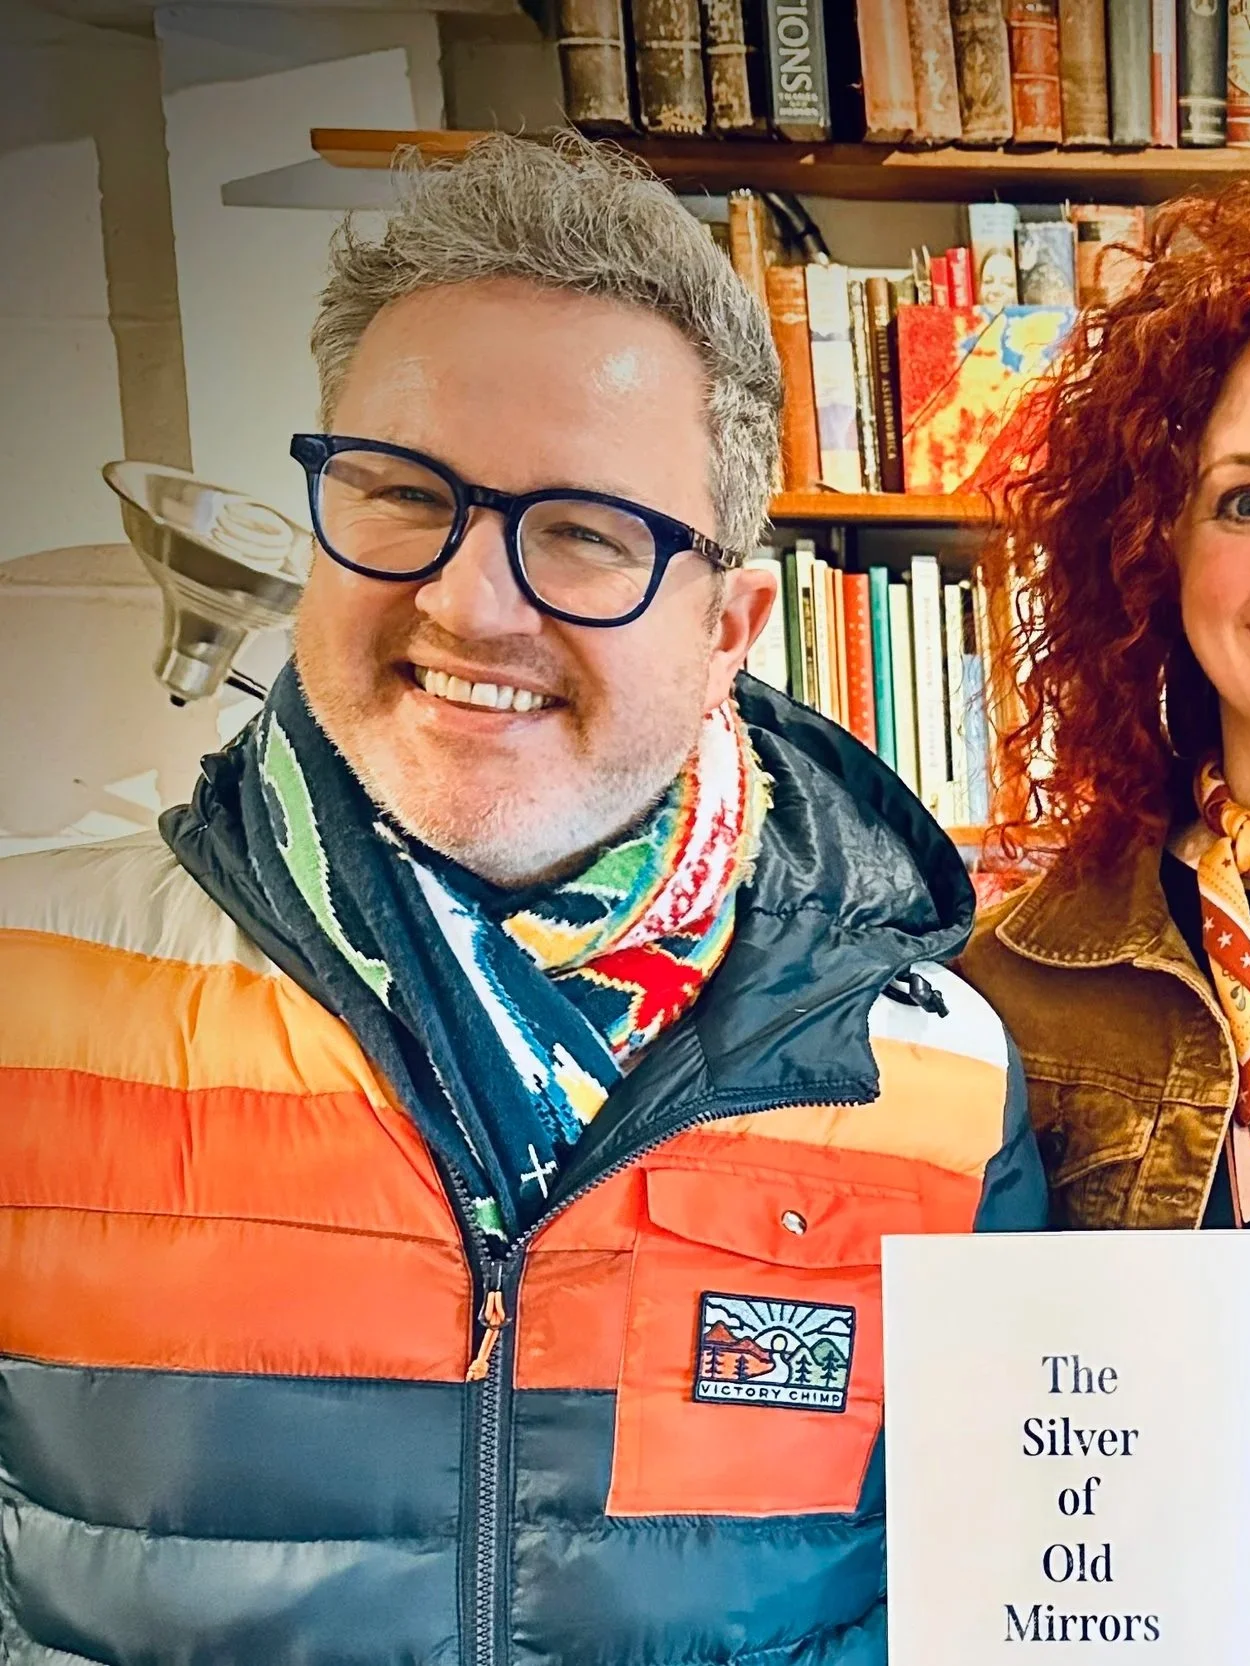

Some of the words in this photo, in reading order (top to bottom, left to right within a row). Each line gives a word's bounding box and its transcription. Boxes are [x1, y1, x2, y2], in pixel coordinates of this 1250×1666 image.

[701, 1384, 782, 1399] VICTORY
[789, 1391, 840, 1404] CHIMP
[1042, 1354, 1118, 1394] The
[1022, 1417, 1140, 1457] Silver
[1058, 1476, 1101, 1516] of
[1042, 1543, 1113, 1583] Old
[1004, 1604, 1160, 1642] Mirrors
